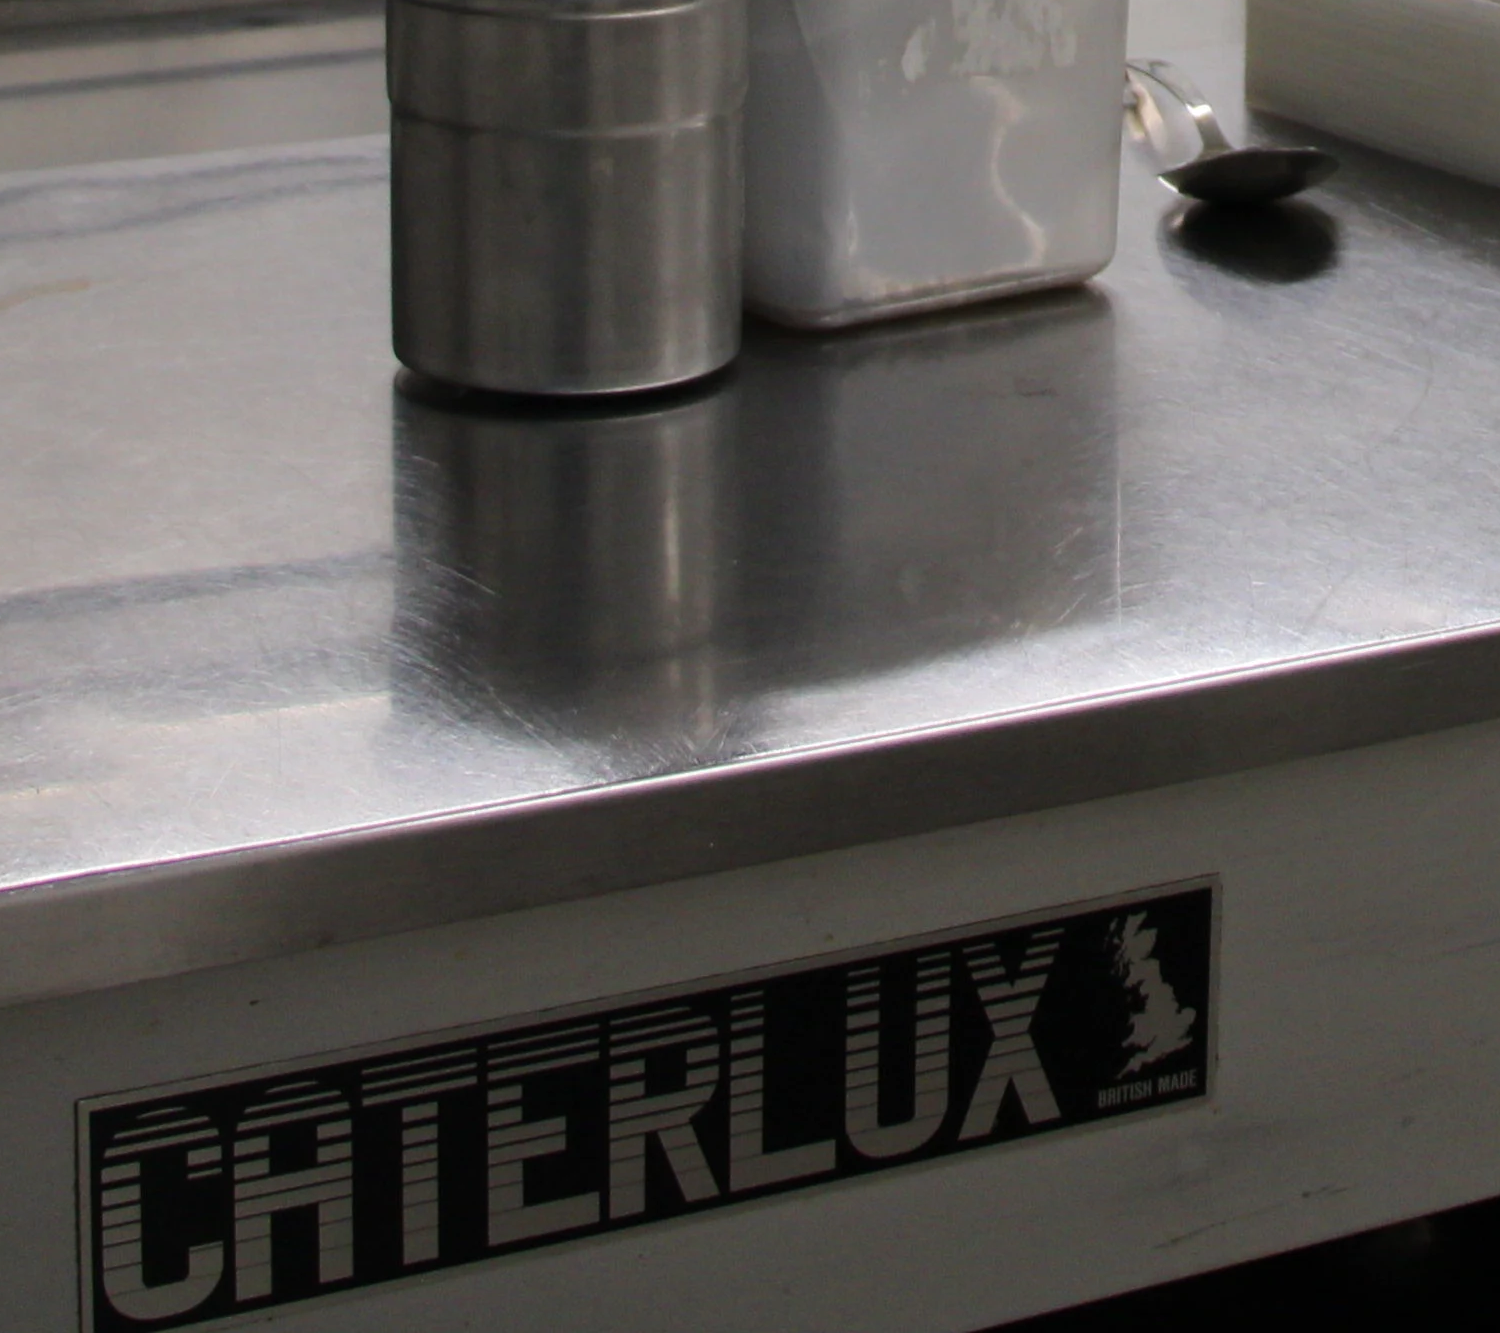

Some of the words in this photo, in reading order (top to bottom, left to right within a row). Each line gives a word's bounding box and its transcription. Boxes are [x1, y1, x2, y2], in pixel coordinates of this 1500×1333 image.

[100, 928, 1064, 1321] CATERLUX
[1097, 1078, 1153, 1109] BRITISH
[1157, 1068, 1198, 1094] MADE
